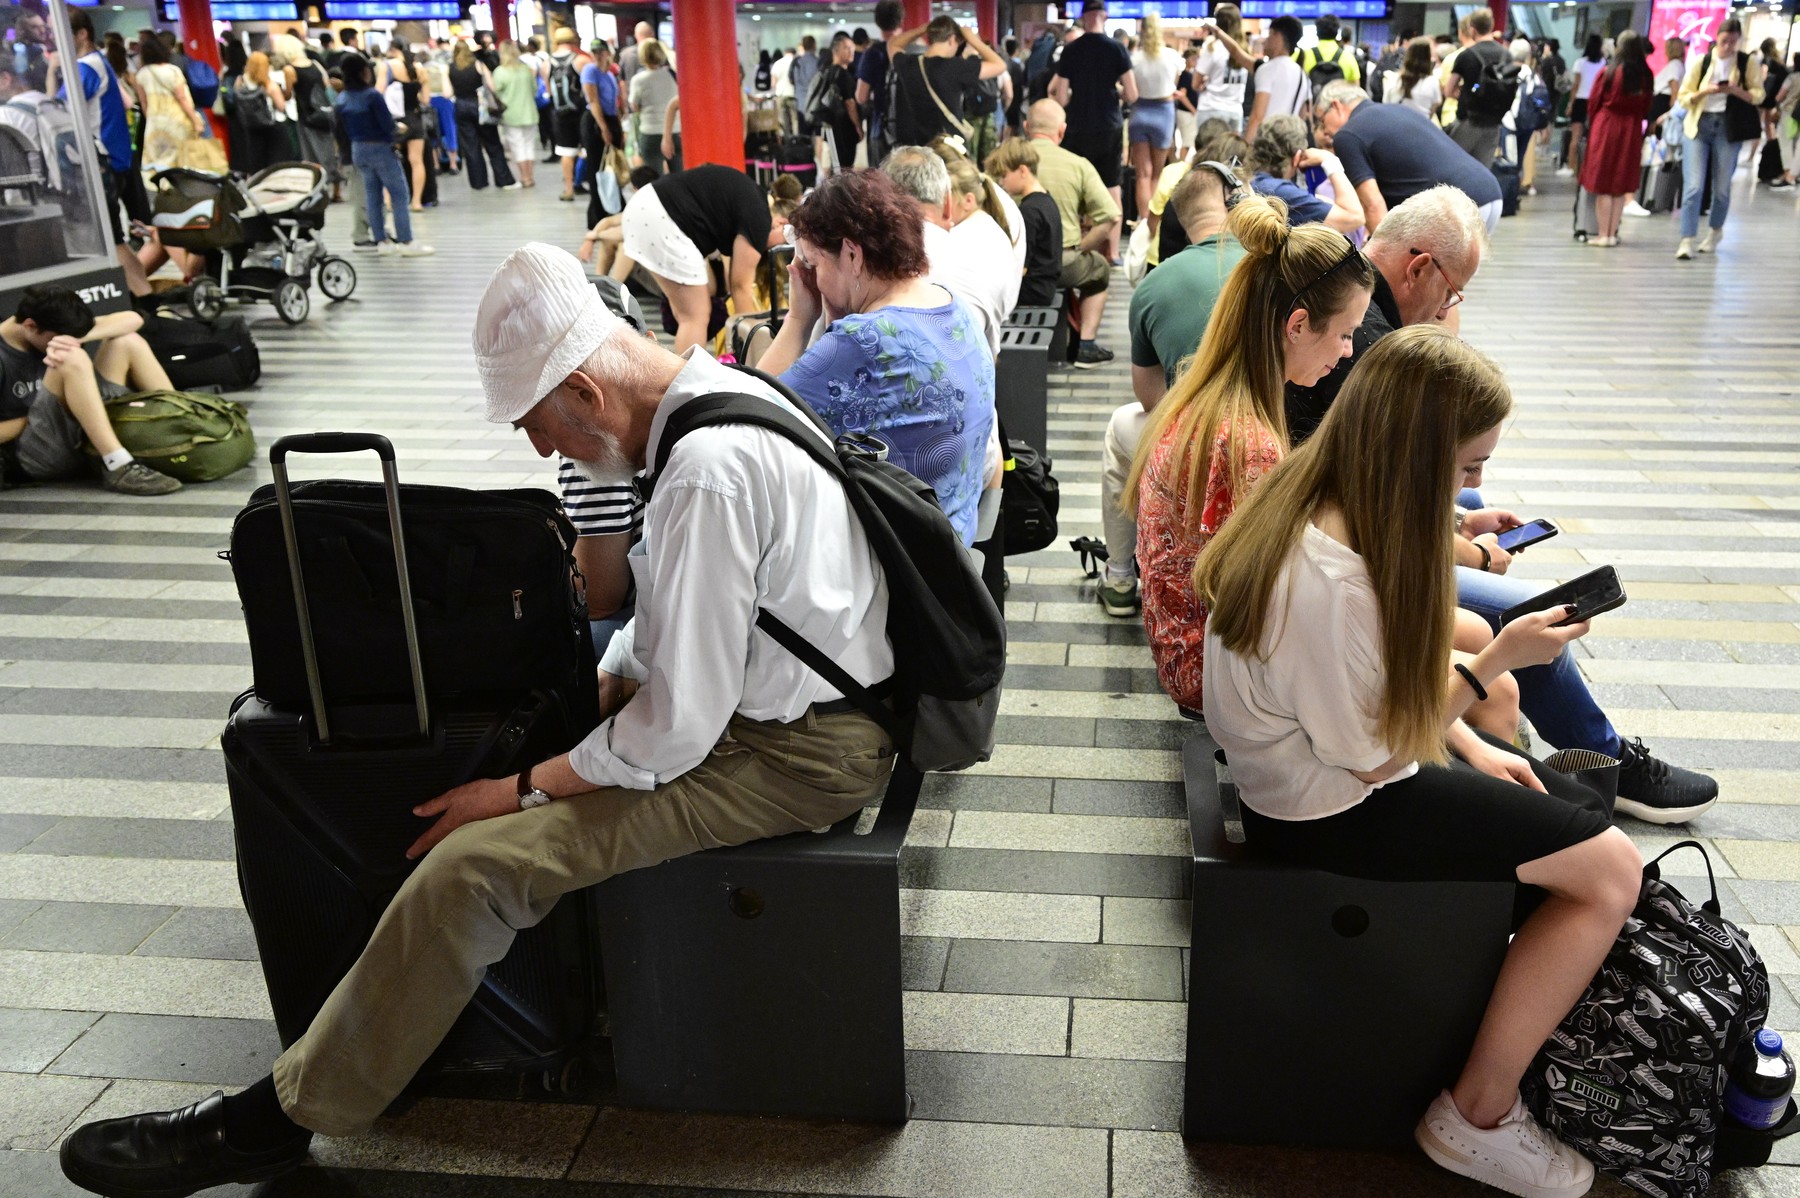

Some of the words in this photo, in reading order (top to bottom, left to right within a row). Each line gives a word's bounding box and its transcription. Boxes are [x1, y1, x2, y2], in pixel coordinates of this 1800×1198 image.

[75, 283, 122, 304] STYL
[1687, 914, 1732, 947] Puma
[1632, 940, 1662, 965] uma
[1615, 1010, 1657, 1049] Puma
[1574, 1081, 1617, 1108] PUMA
[1629, 1063, 1674, 1100] Puma
[1598, 1135, 1645, 1157] Puma
[1645, 1134, 1690, 1171] 75
